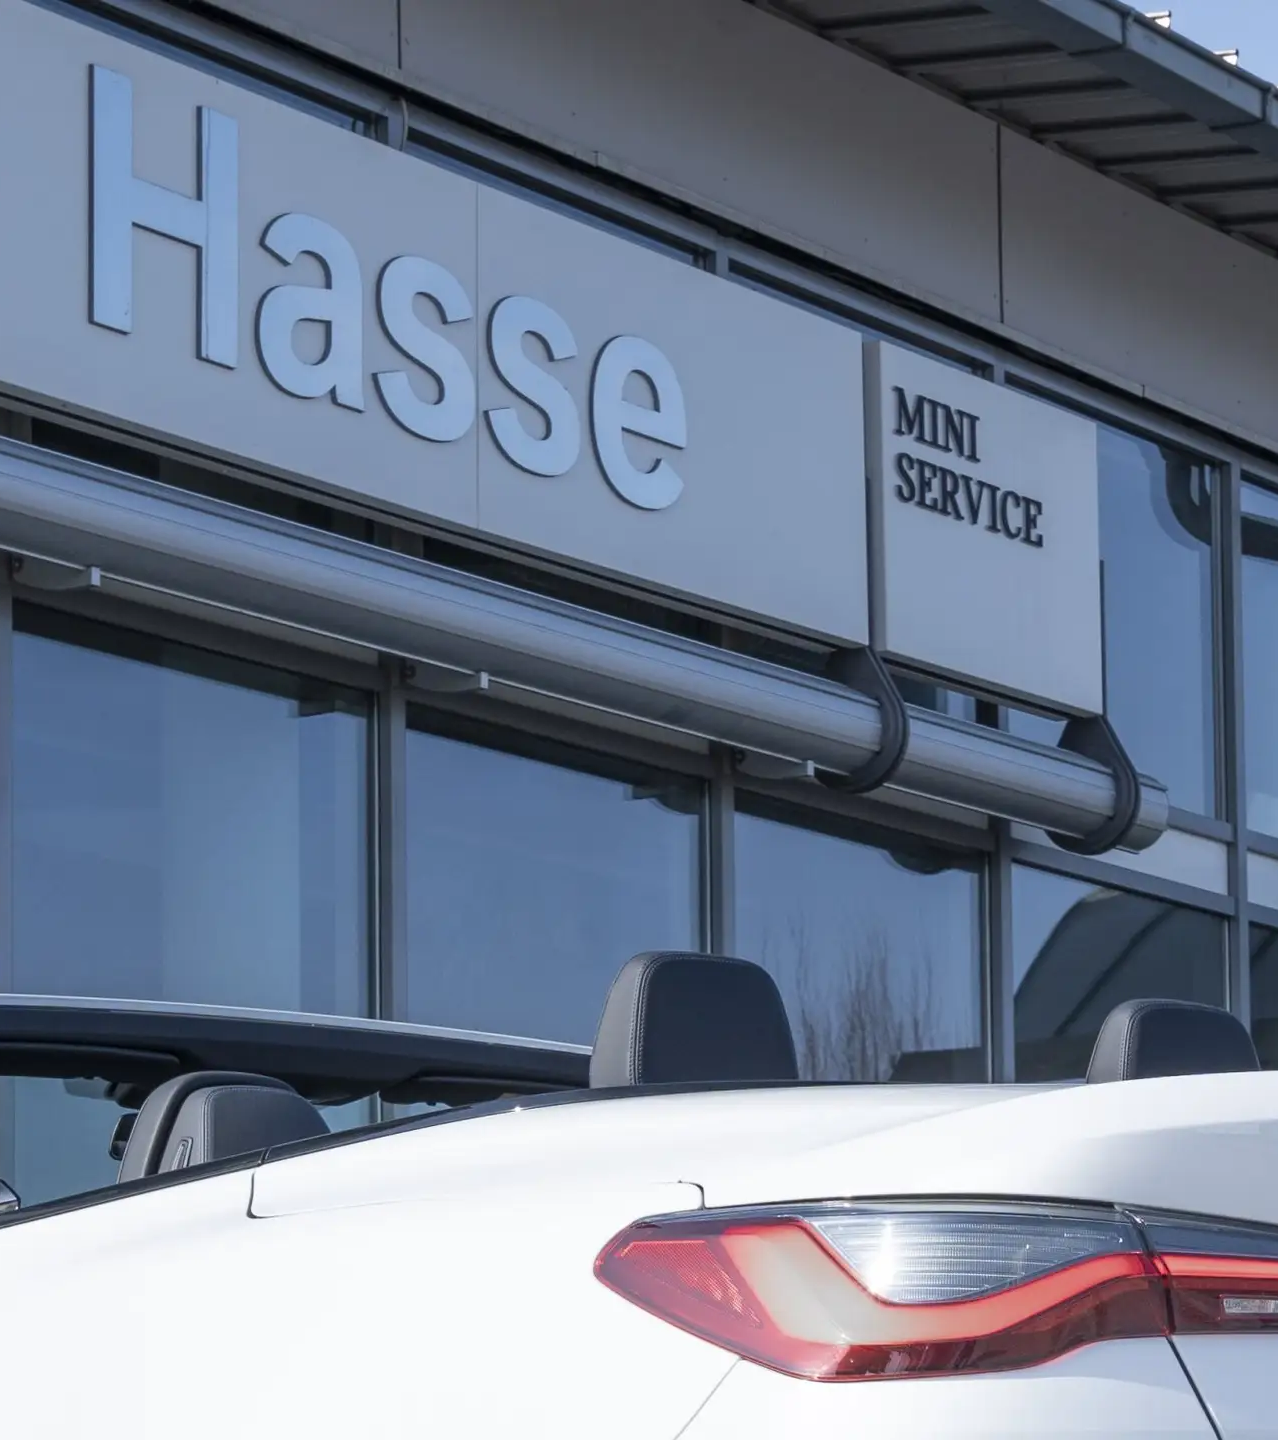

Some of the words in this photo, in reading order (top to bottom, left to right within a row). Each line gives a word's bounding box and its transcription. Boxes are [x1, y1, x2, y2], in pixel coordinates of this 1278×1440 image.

[88, 63, 687, 511] Hasse
[892, 385, 980, 463] MINI
[895, 452, 1043, 548] SERVICE
